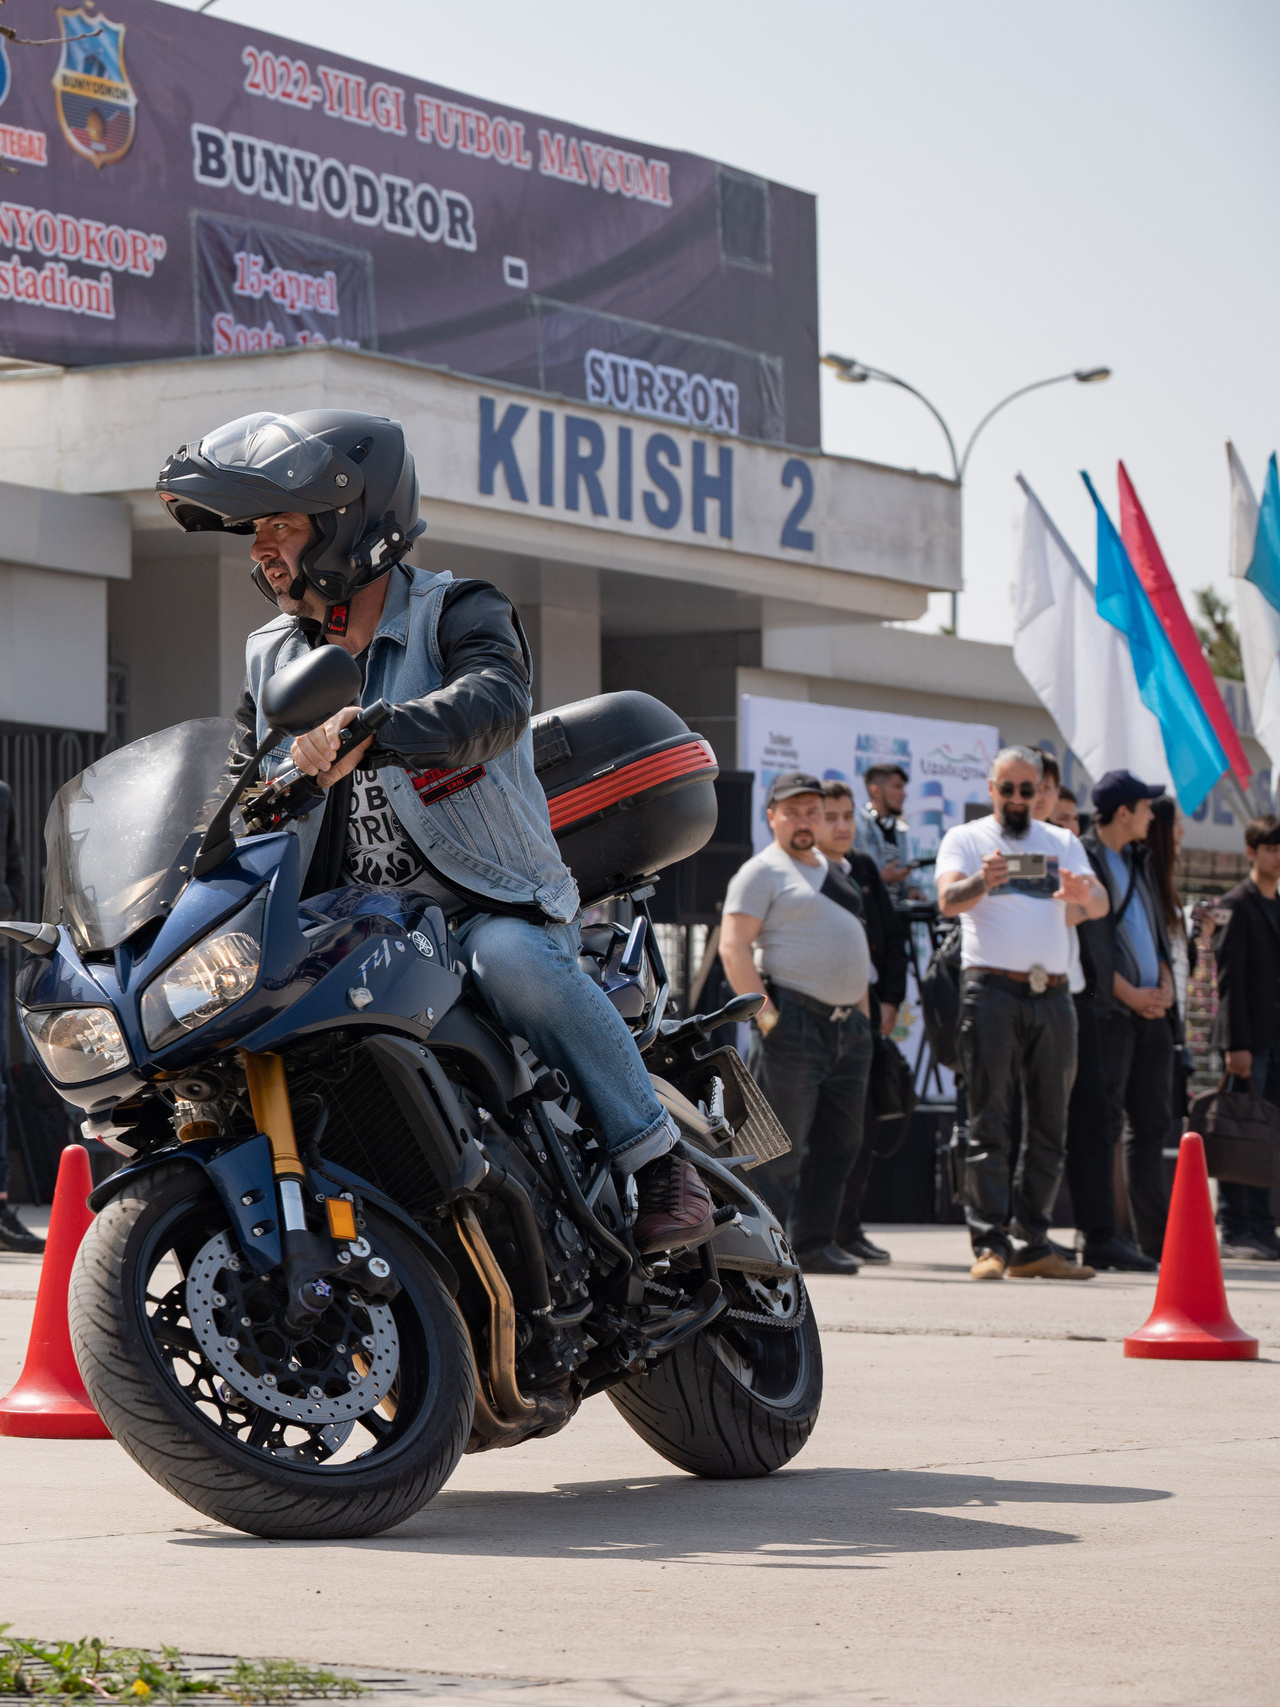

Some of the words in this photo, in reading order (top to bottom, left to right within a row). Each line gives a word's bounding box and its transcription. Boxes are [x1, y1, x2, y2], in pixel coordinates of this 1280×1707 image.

[194, 125, 476, 250] BUNYODKOR
[243, 46, 406, 134] 2022-YILGI
[417, 94, 532, 169] FUTBOL
[538, 129, 673, 208] MAVSUMI
[235, 253, 338, 313] 15-aprel
[586, 349, 738, 433] SURXON
[479, 395, 734, 540] KIRISH
[781, 458, 815, 552] 2
